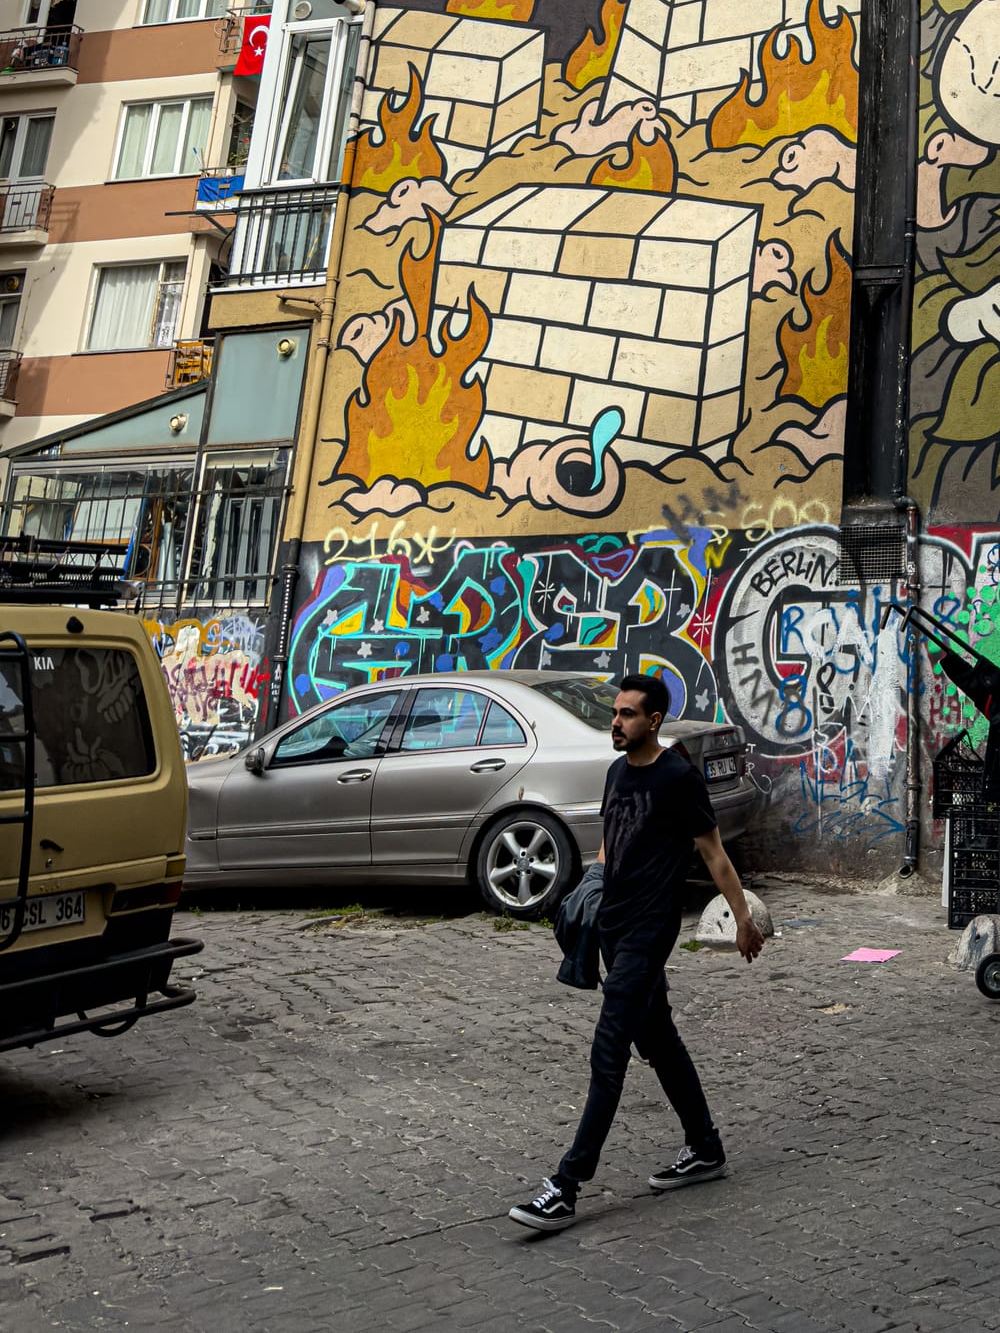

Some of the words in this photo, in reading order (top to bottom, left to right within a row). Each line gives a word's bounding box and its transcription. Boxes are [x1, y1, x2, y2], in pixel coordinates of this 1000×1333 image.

[33, 656, 55, 670] KIA
[0, 907, 10, 931] 6
[56, 895, 81, 921] 364
